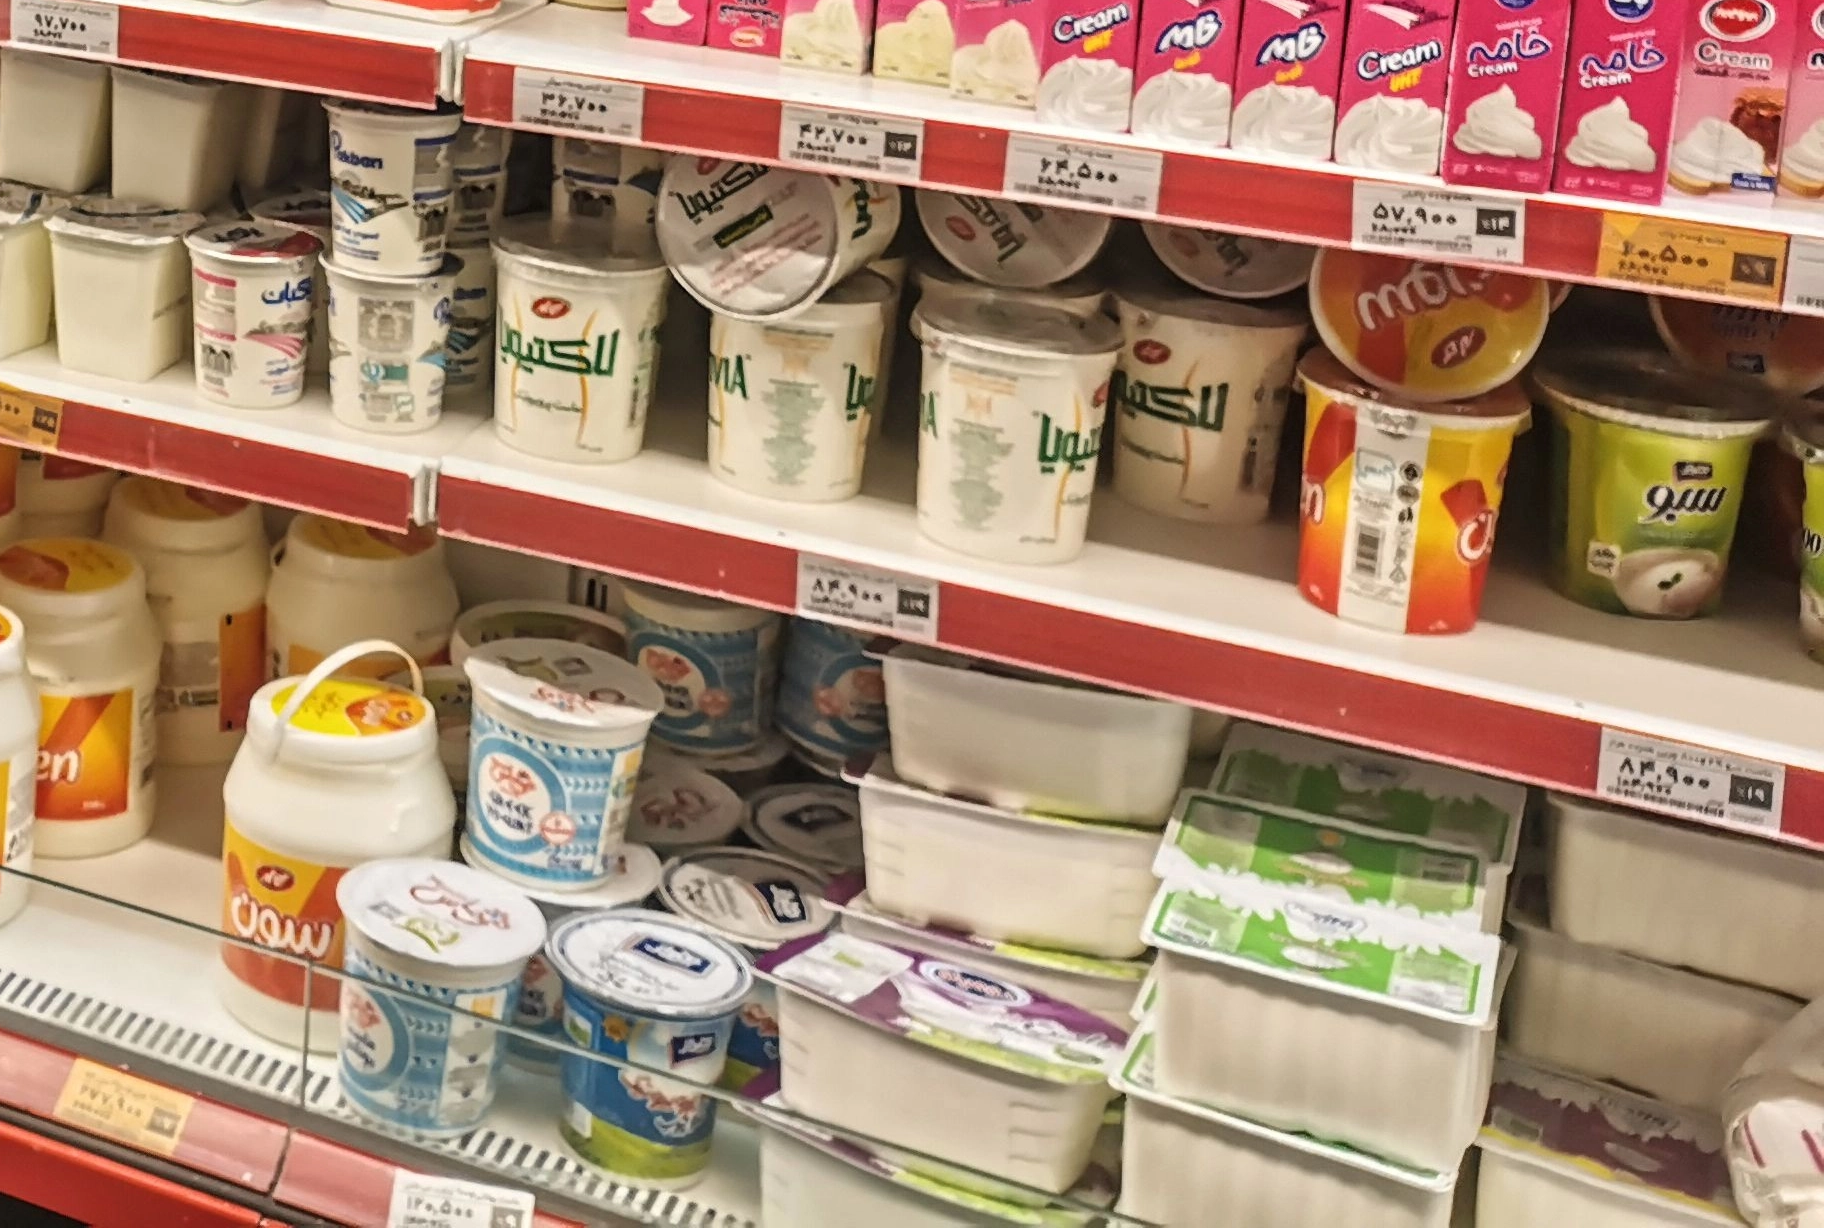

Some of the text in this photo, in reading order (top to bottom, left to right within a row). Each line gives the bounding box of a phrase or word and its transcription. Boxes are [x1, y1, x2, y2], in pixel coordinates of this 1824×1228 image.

[1052, 3, 1130, 43] Cream
[1356, 40, 1442, 81] Cream
[1468, 26, 1553, 63] خامه
[1580, 39, 1666, 74] خامه
[1697, 41, 1772, 70] Cream
[1580, 72, 1633, 89] Cream
[229, 890, 334, 961] سون
